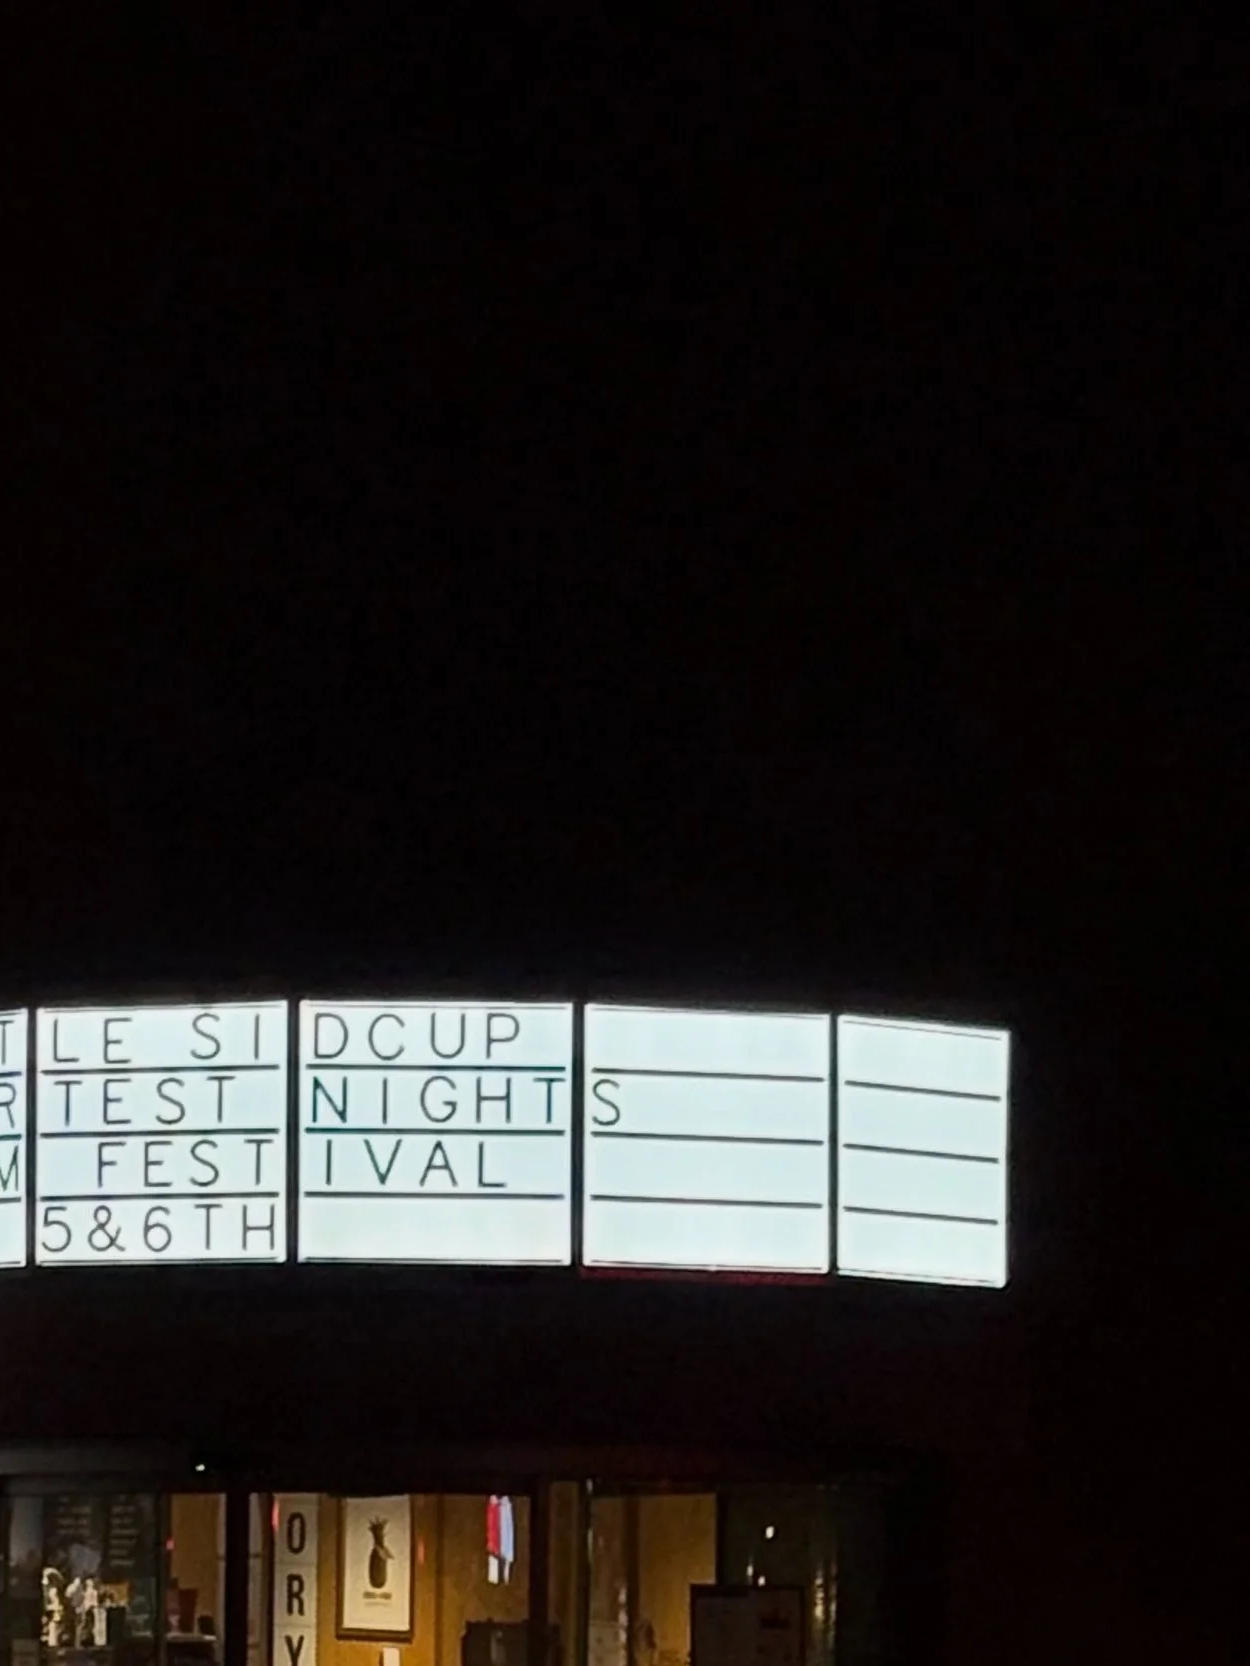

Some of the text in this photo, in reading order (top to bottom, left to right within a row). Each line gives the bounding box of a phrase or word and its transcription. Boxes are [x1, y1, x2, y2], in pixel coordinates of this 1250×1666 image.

[189, 1012, 521, 1061] SIDCUP
[312, 1075, 623, 1128] NIGHTS
[97, 1138, 507, 1189] FESTIVAL
[41, 1203, 277, 1254] 5&6TH
